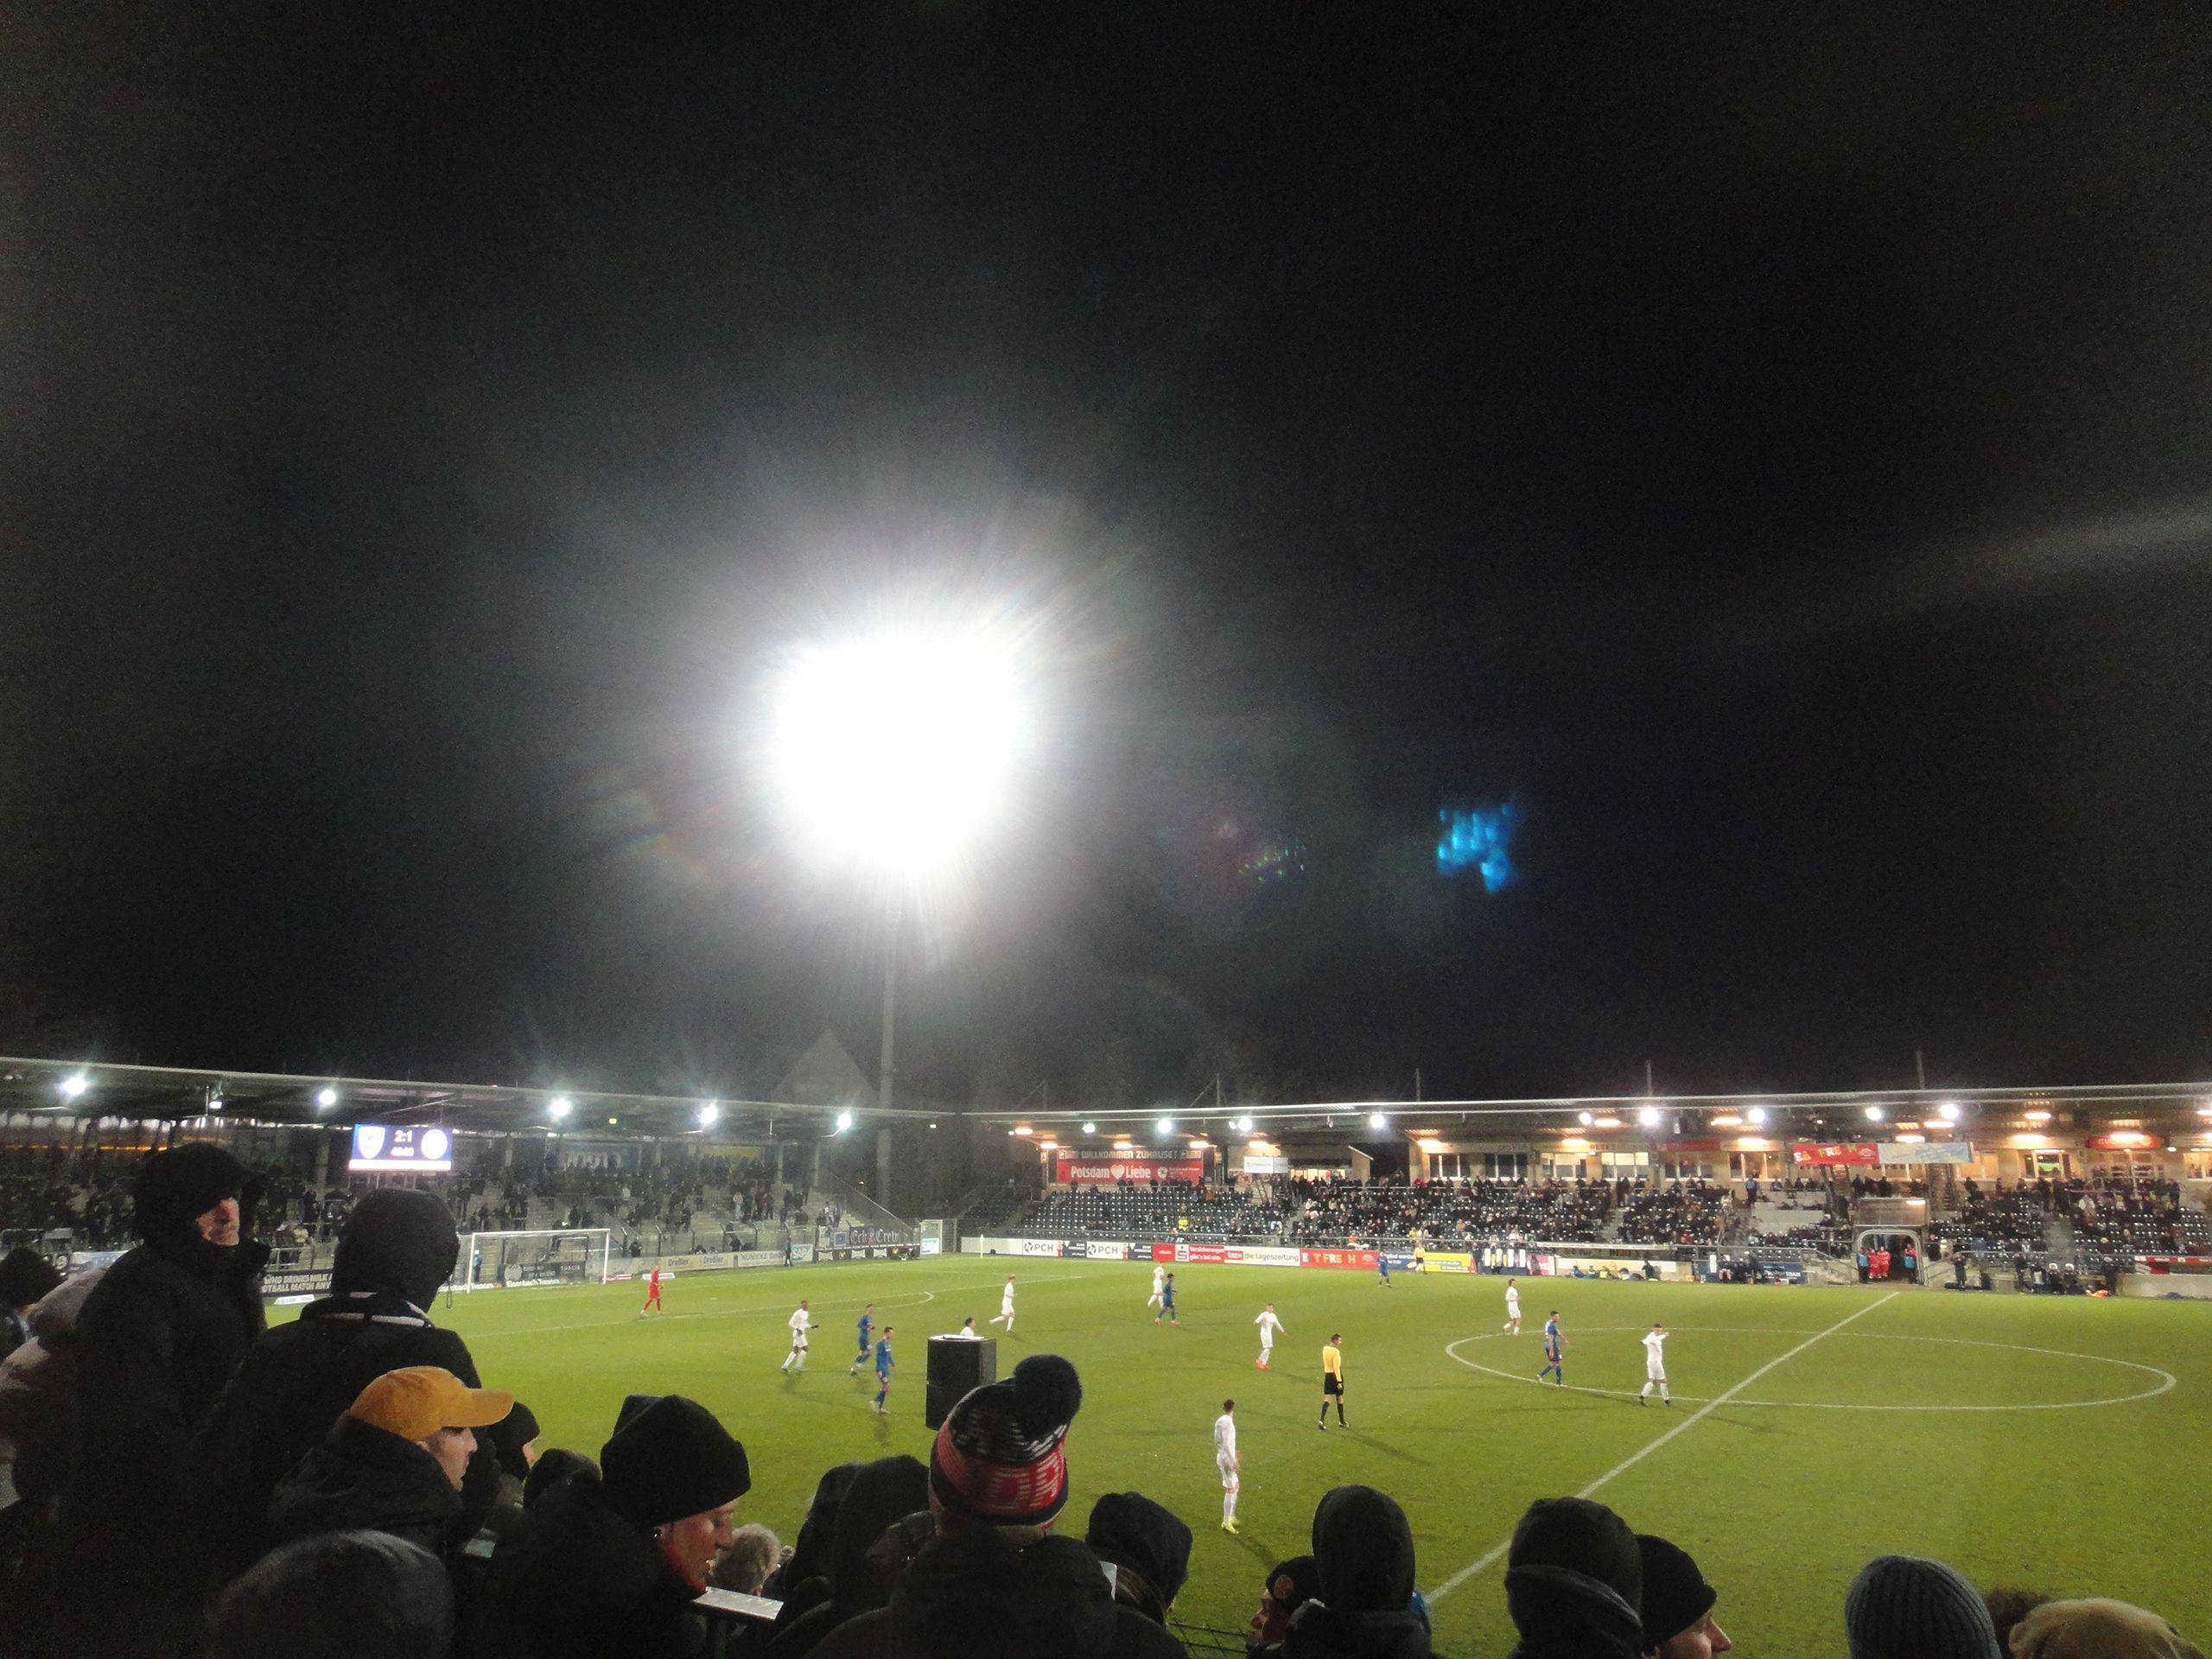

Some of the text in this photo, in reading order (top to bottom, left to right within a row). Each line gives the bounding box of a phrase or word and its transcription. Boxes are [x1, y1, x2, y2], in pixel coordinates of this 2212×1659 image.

[394, 1129, 413, 1142] 2:1
[1071, 1164, 1109, 1179] Potsdam
[1126, 1164, 1152, 1179] Liebe
[1034, 1243, 1053, 1252] PCH
[1097, 1246, 1118, 1255] PCH
[1255, 1252, 1299, 1262] tageszeitung
